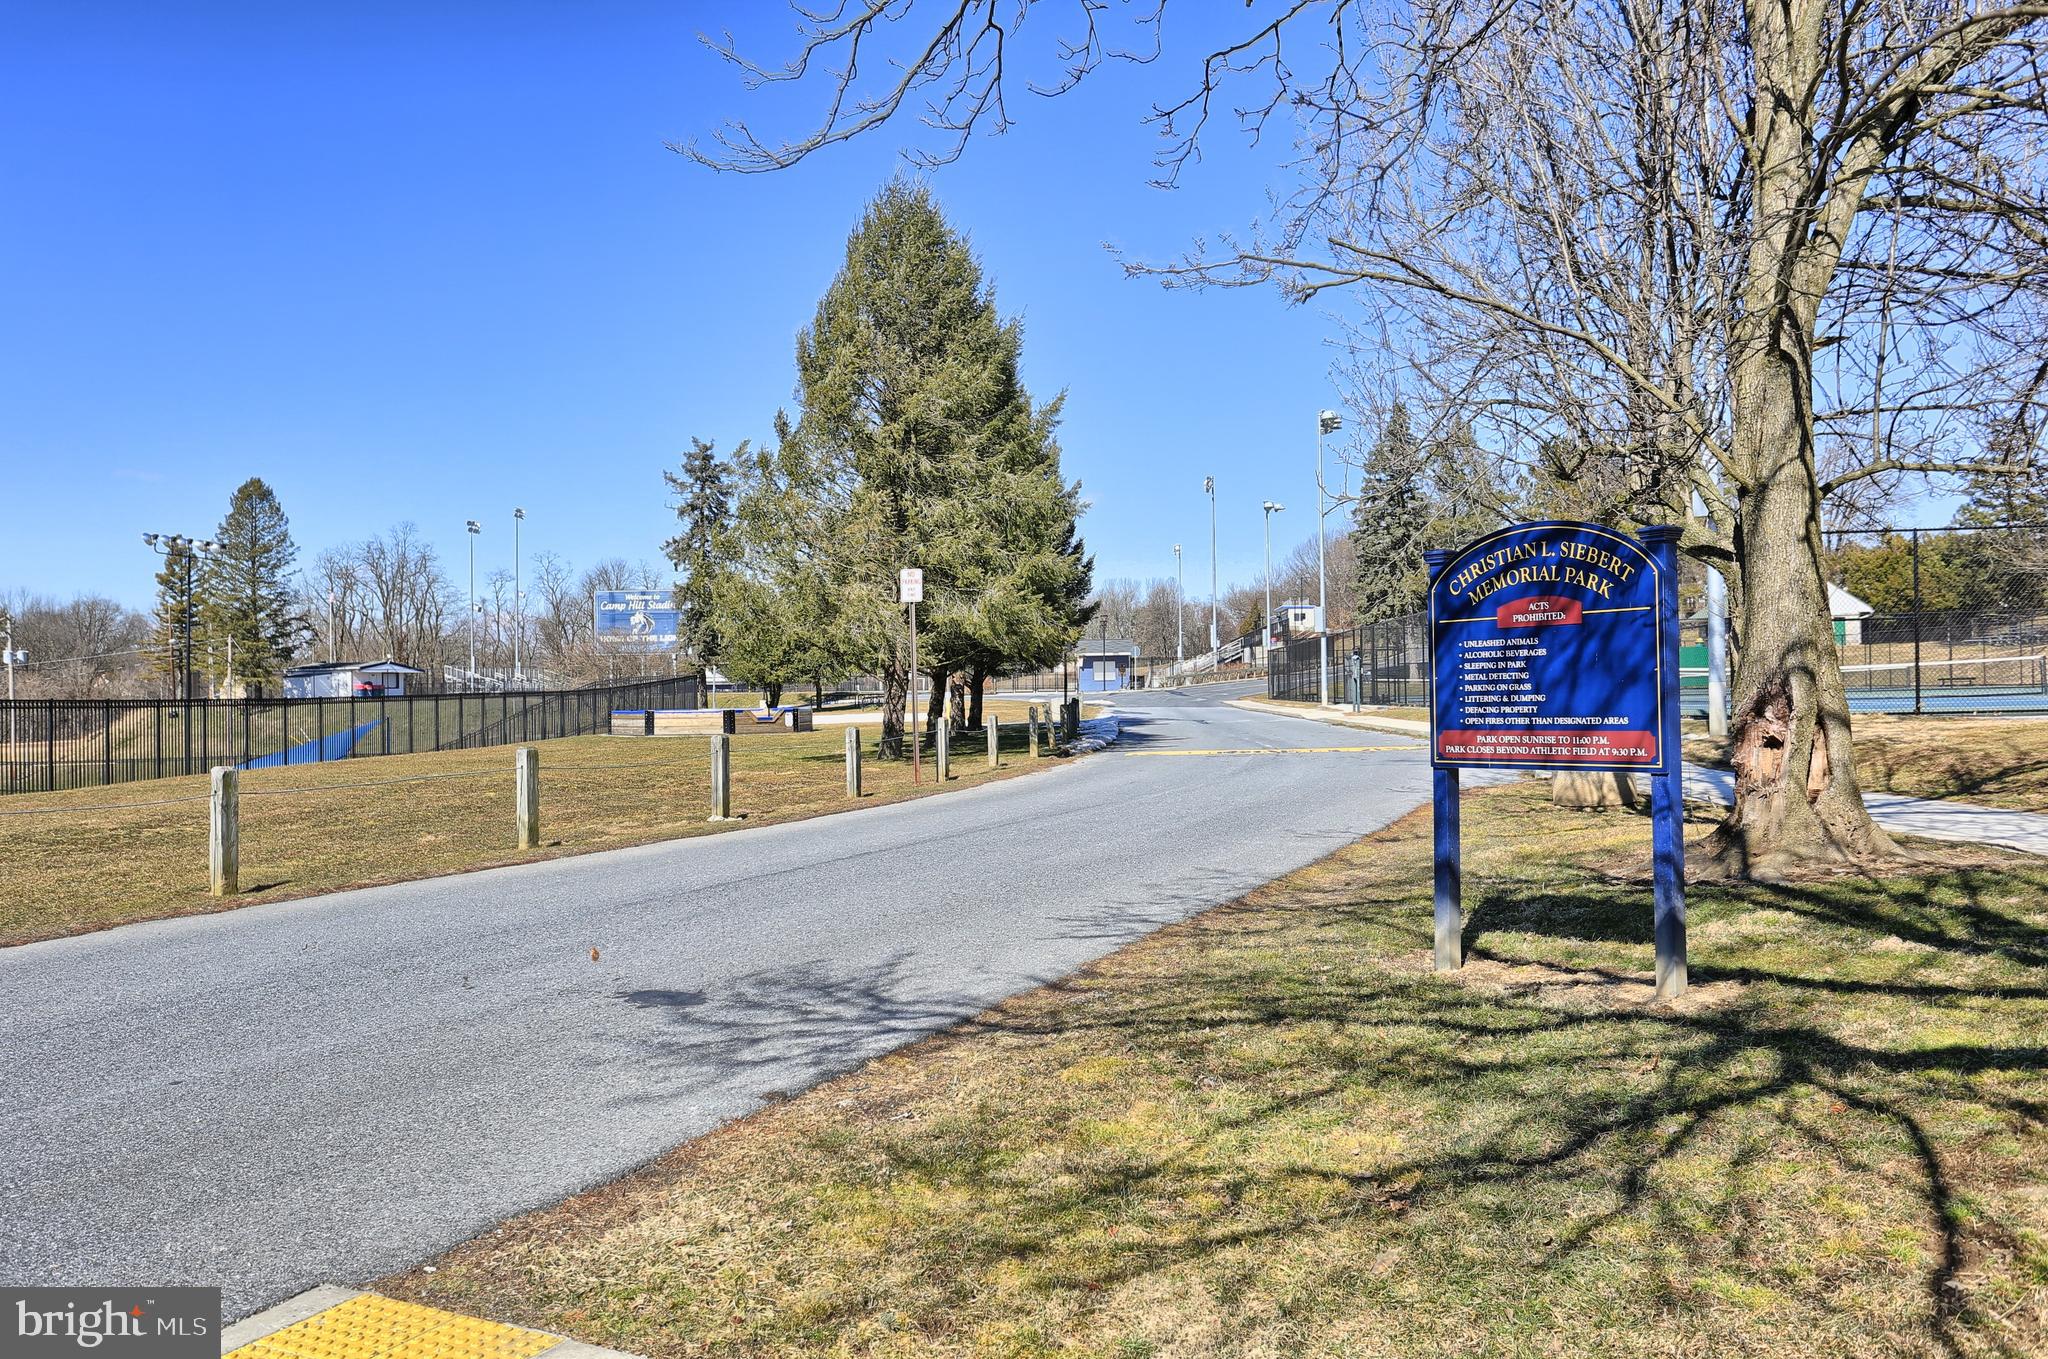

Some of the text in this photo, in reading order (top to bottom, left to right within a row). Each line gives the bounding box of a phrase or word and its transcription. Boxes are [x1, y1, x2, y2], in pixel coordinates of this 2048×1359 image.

[1449, 541, 1635, 596] CHRISTIAN L. SIEBERT
[1468, 565, 1615, 606] MEMORIAL PARK
[600, 601, 626, 611] Camp
[628, 600, 645, 609] Hill
[1528, 602, 1550, 611] ACTS
[1512, 612, 1566, 622] PROHIBITED:
[1464, 638, 1538, 648] UNLEASHED ANIMALS
[1464, 649, 1547, 659] ALCOHOLIC BEVERAGES
[1489, 672, 1529, 680] DETECTING
[1477, 736, 1609, 745] PARK OPEN SUNRISE TO 11:00 P.M.
[1572, 747, 1597, 755] FIELD
[1612, 748, 1628, 756] 9:30
[1630, 748, 1648, 756] P.M.
